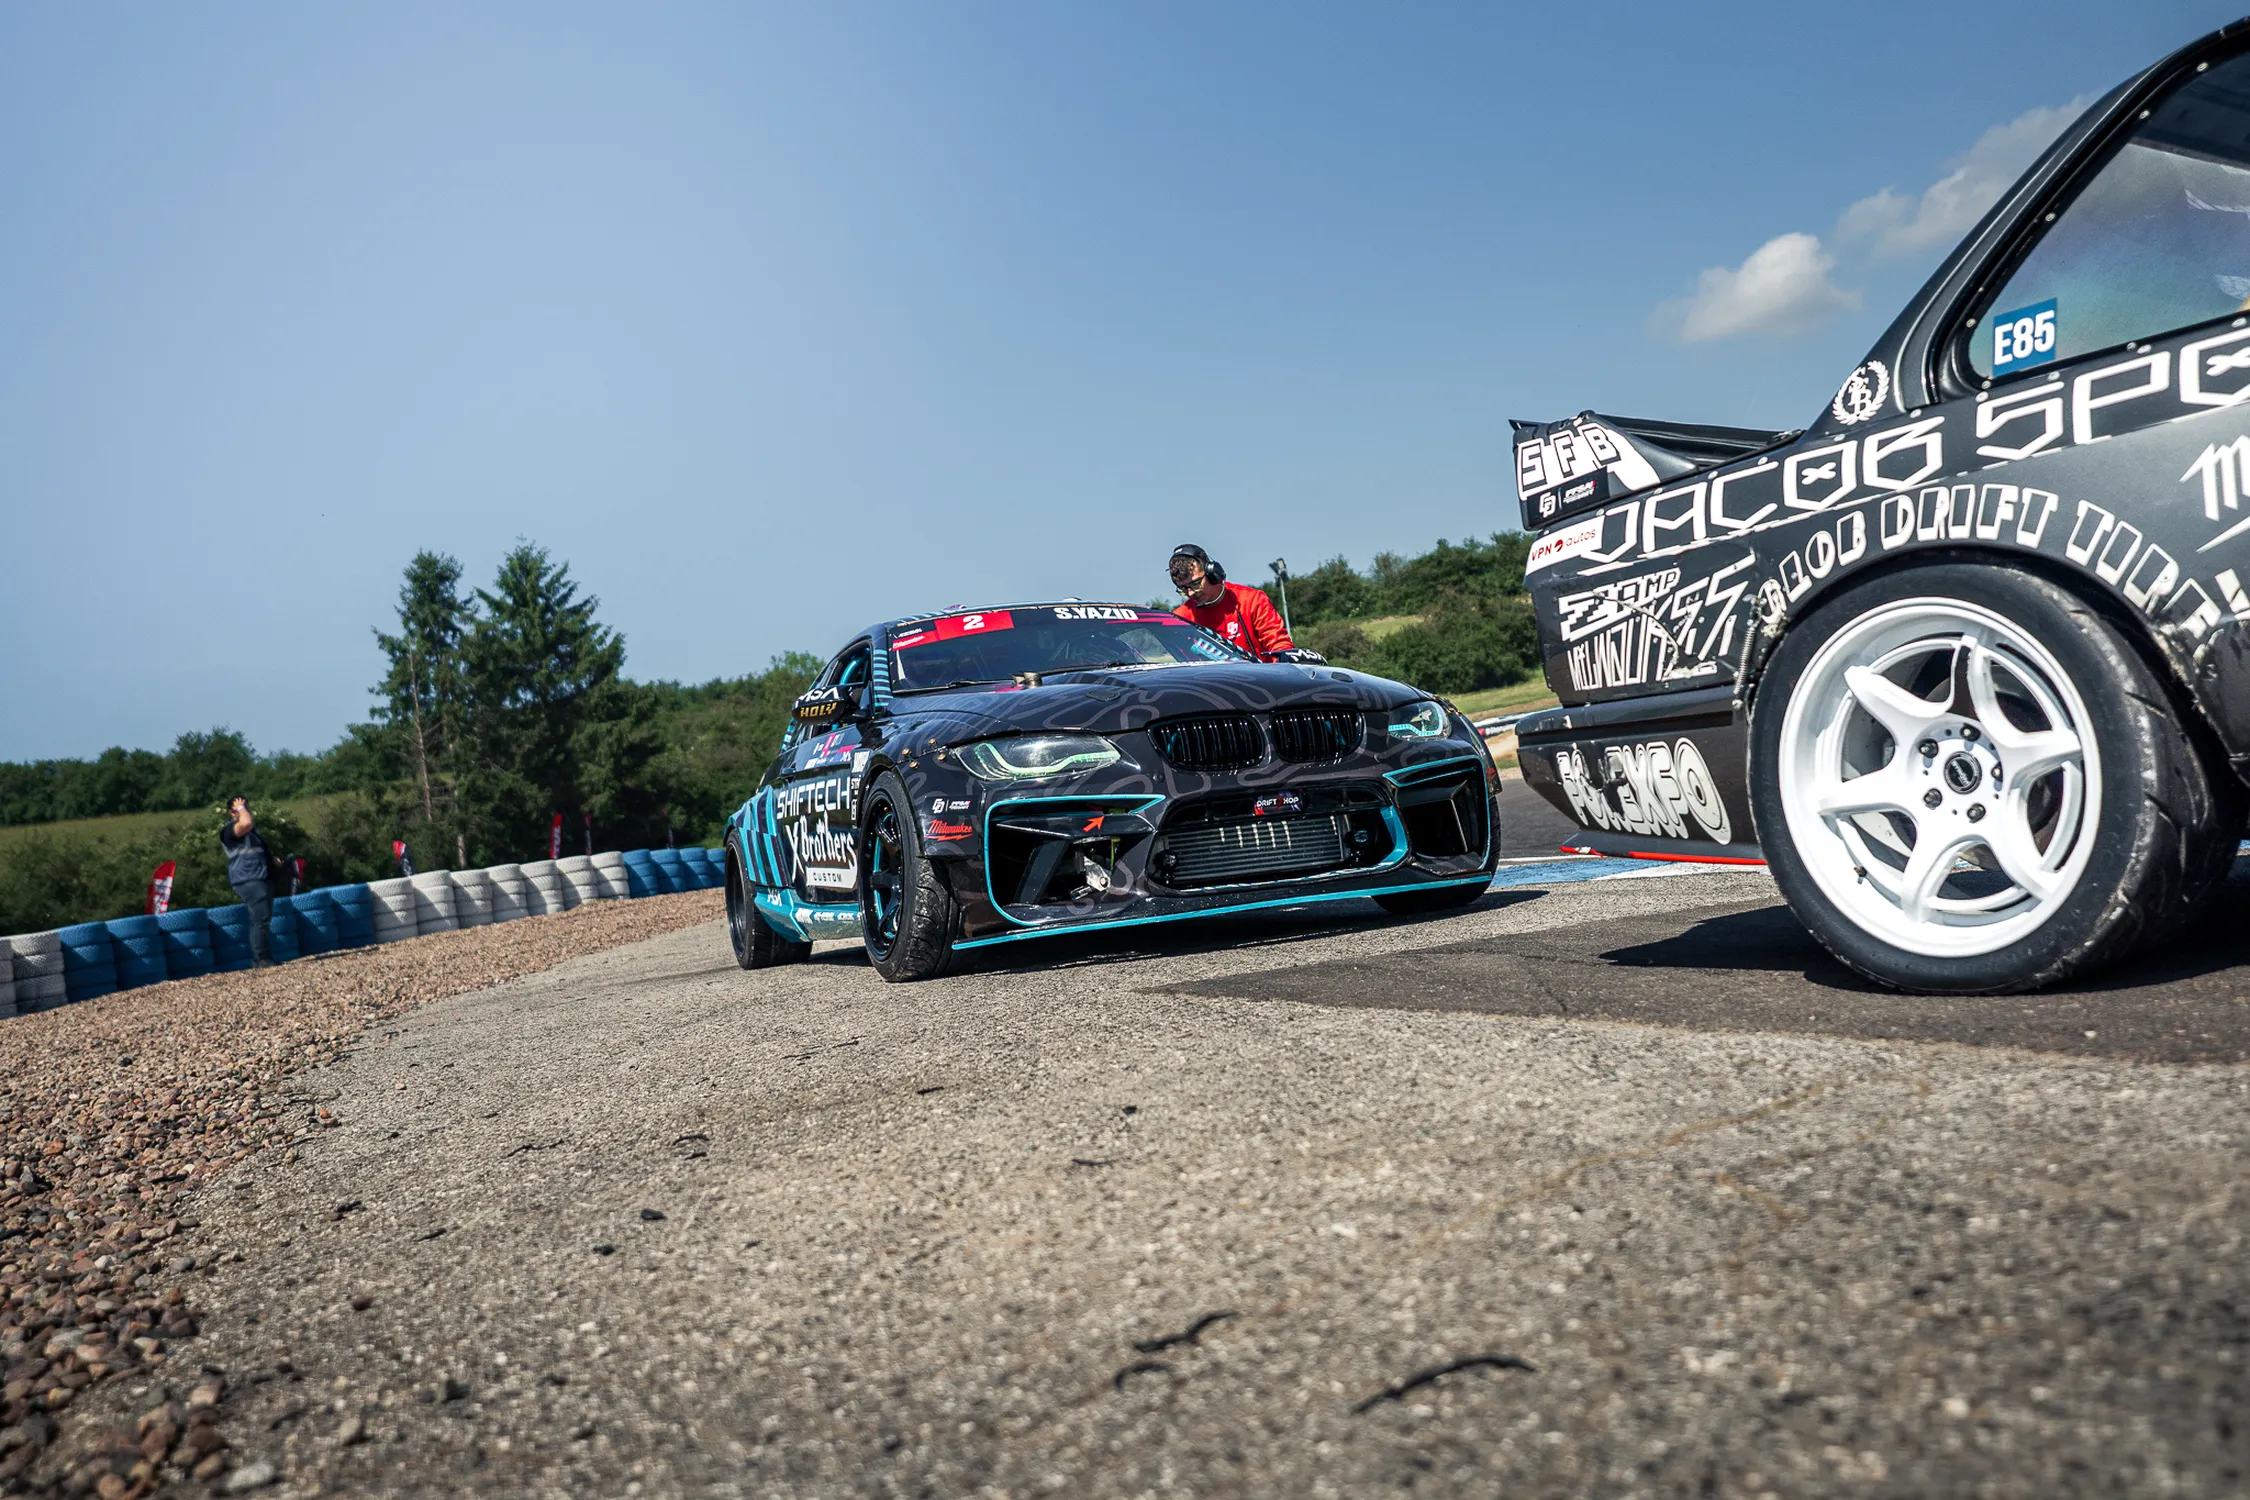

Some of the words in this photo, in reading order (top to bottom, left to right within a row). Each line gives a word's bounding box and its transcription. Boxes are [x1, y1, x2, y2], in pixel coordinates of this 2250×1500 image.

[1994, 310, 2056, 365] E85
[1518, 424, 1622, 494] SFB
[1580, 416, 1945, 563] JACOB
[1880, 483, 2059, 551] DRIFT
[1531, 543, 1553, 561] VPN
[1566, 529, 1596, 547] autos
[962, 614, 985, 631] 2
[1053, 607, 1139, 620] S.YAZID
[800, 702, 838, 718] HOLY
[776, 776, 851, 820] SHIFTECH
[927, 819, 973, 835] Milwaukee
[813, 872, 843, 883] CUSTOM
